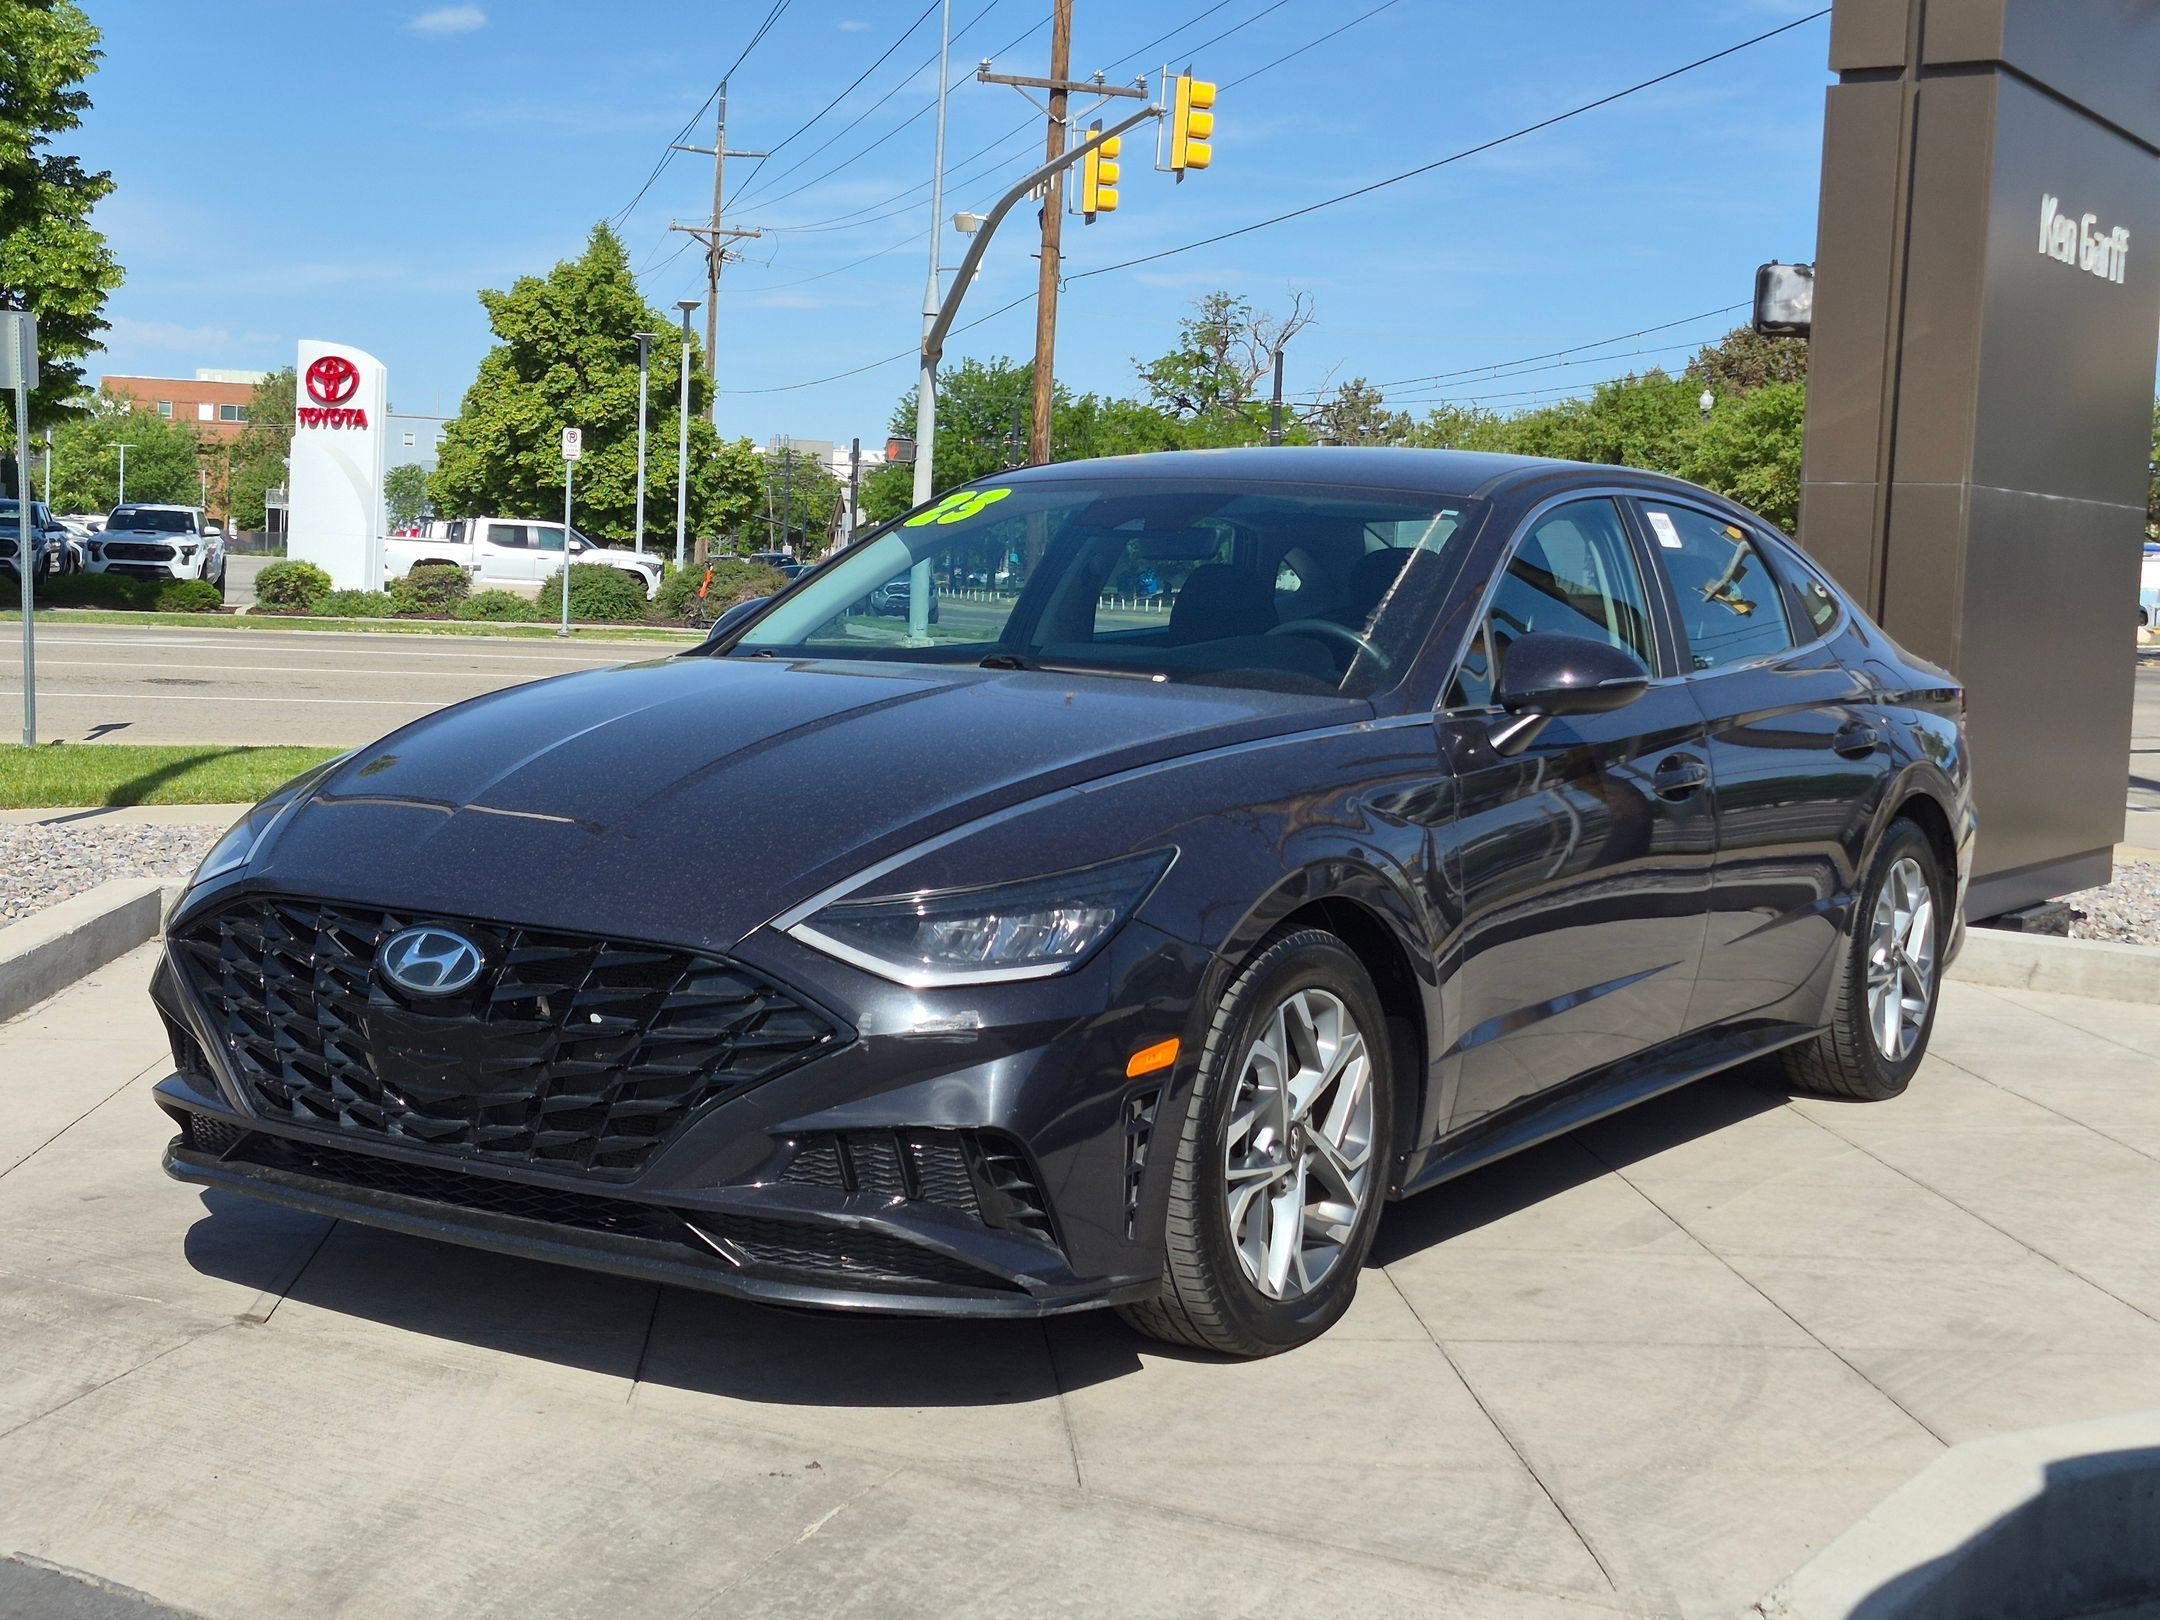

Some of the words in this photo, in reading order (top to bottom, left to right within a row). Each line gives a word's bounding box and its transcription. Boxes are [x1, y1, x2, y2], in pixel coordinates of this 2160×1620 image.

[2038, 193, 2077, 265] Ken
[2079, 213, 2130, 284] Garff
[297, 407, 368, 430] TOYOTA
[902, 488, 1012, 525] 23
